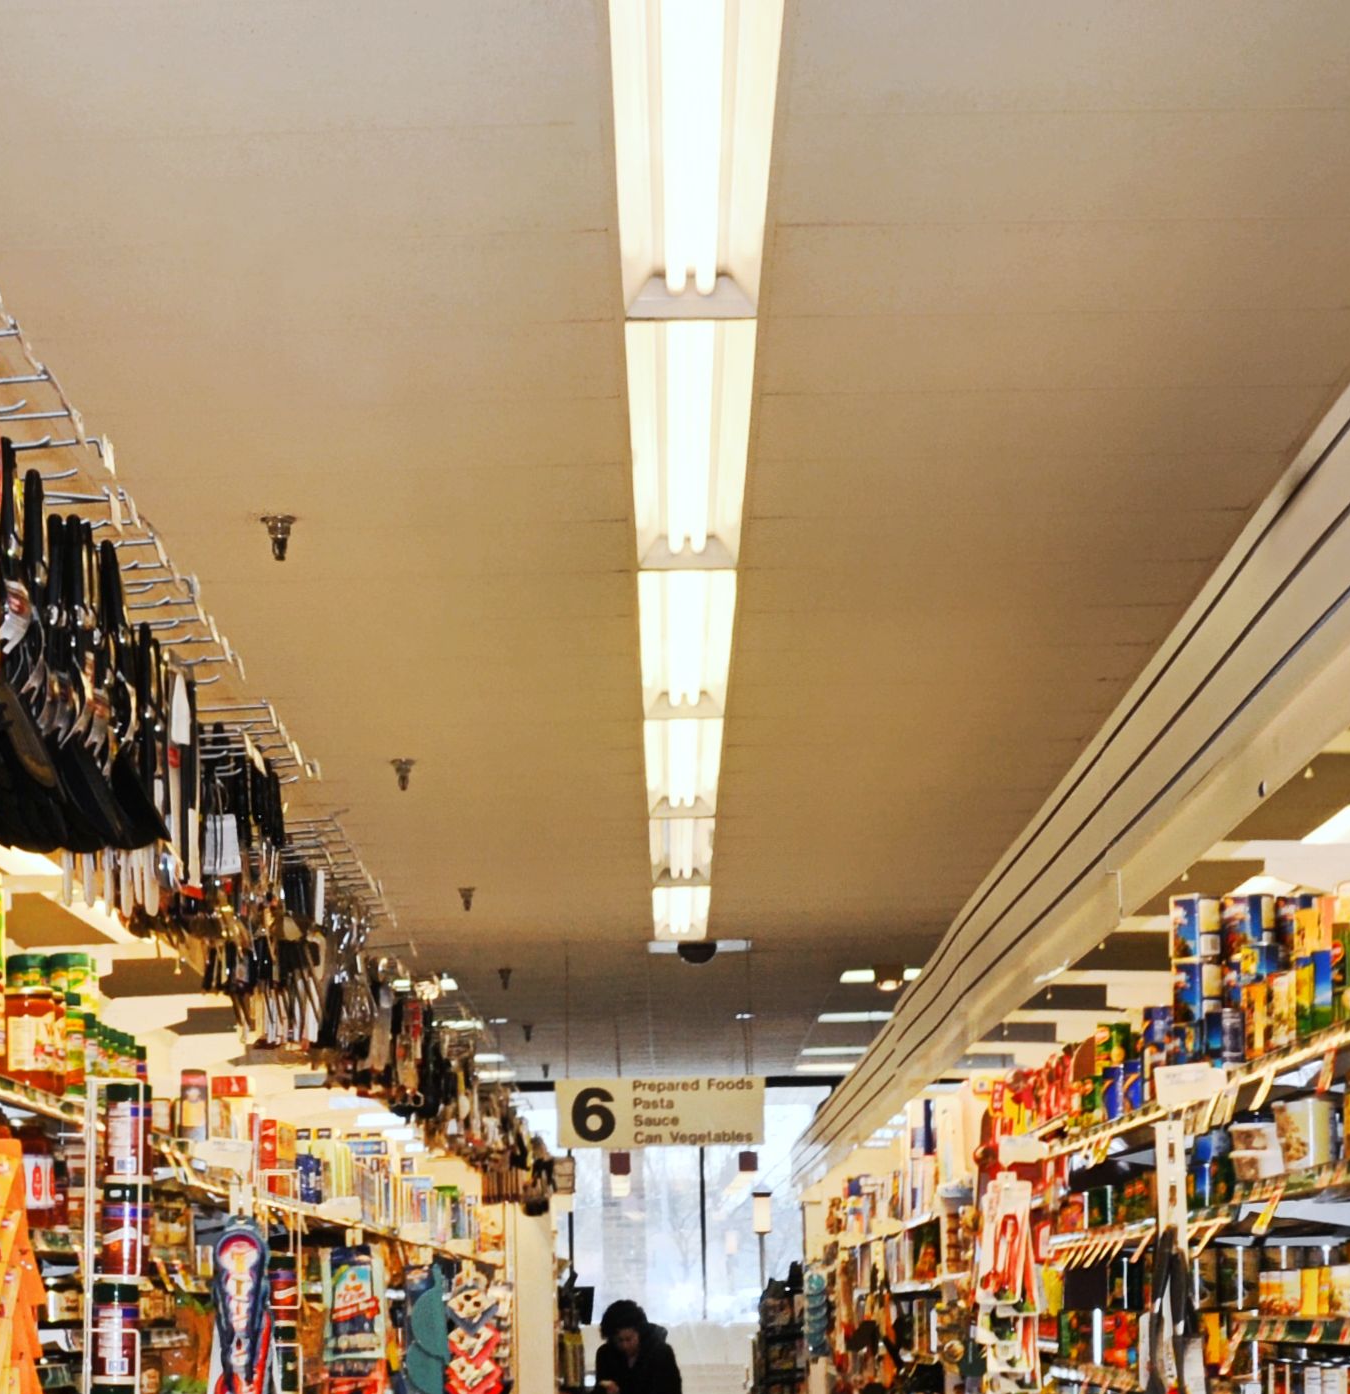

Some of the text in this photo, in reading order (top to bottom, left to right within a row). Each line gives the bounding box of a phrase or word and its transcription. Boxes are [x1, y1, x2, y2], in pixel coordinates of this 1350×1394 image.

[632, 1078, 754, 1093] Prepared Foods
[633, 1098, 675, 1109] Pasta
[572, 1087, 616, 1142] 6
[634, 1114, 680, 1127] Sauce
[634, 1131, 754, 1145] Can Vegetables
